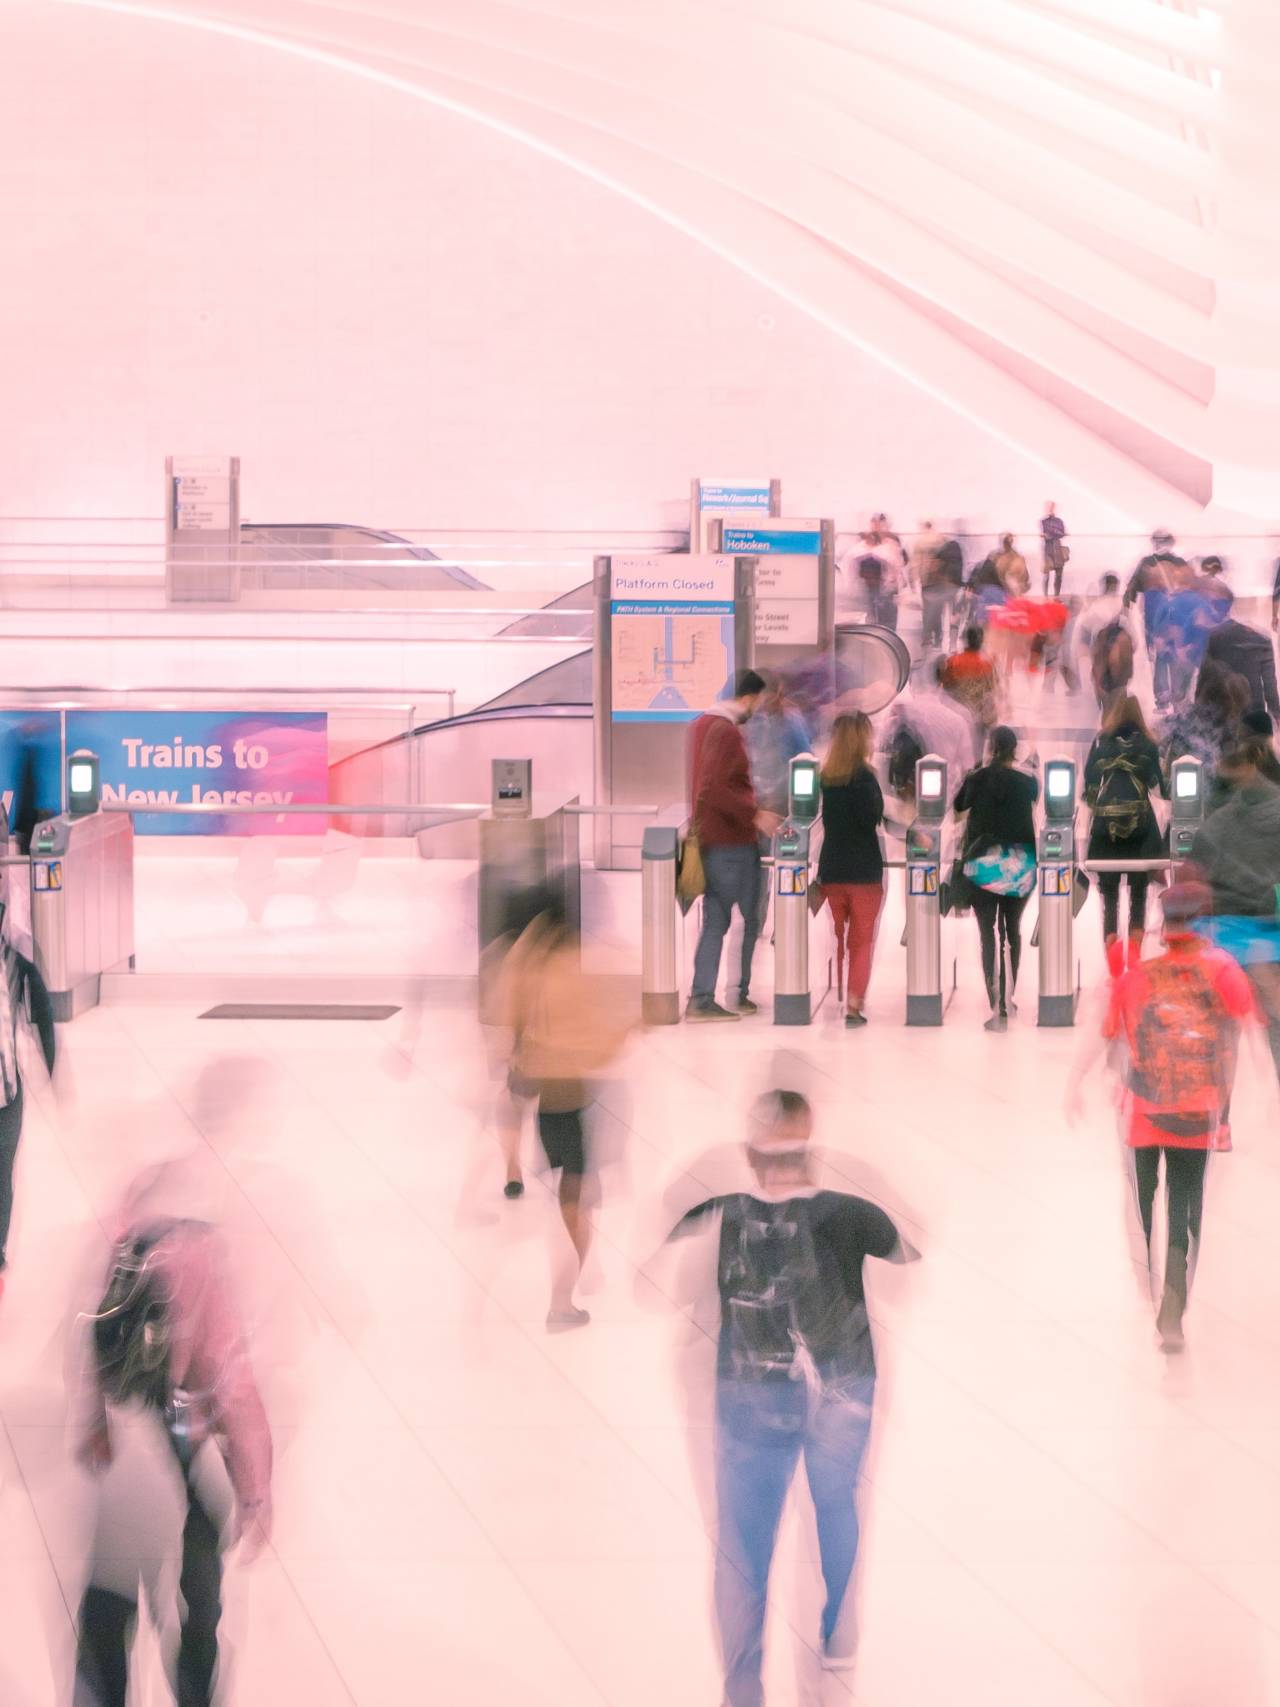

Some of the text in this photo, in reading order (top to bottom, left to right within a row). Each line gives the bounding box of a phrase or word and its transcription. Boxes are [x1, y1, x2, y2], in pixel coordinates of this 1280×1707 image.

[727, 539, 770, 551] Hoboken
[616, 578, 715, 590] Platform Closed
[121, 736, 270, 769] Trains to
